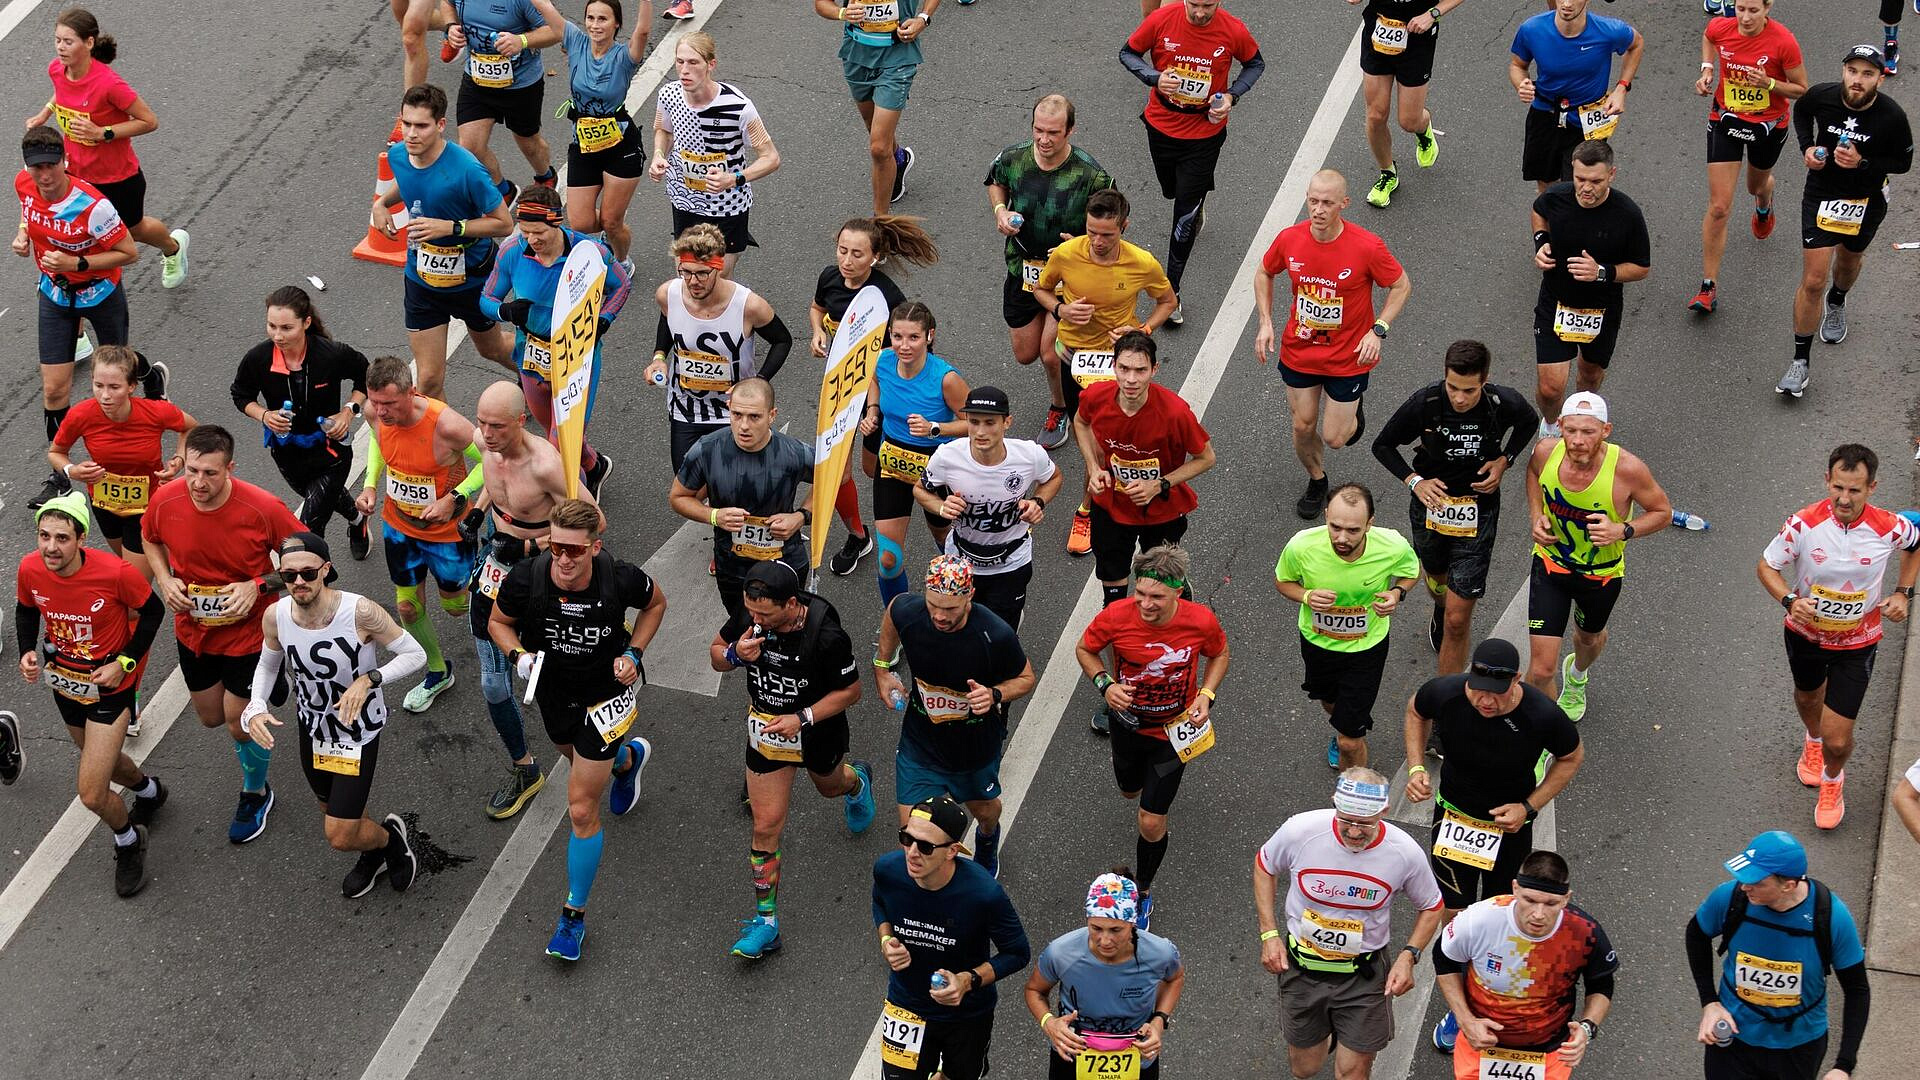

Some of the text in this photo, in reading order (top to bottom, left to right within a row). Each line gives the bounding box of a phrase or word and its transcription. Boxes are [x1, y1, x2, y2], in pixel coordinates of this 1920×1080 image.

[860, 4, 893, 18] 754
[472, 60, 510, 76] 16359
[1174, 55, 1213, 66] МАРАФОН
[1170, 76, 1205, 94] 157
[1731, 87, 1763, 102] 1866
[578, 120, 616, 140] 15521
[1727, 127, 1757, 142] Flinch
[1827, 125, 1871, 142] SAYSKY
[684, 163, 726, 176] 143
[1825, 201, 1864, 218] 14973
[101, 227, 122, 242] VOLGA
[422, 253, 458, 270] 7647
[1024, 266, 1042, 281] 13
[1299, 275, 1338, 288] МАРАФОН
[1300, 297, 1341, 319] 15023
[1559, 311, 1602, 330] 13545
[554, 299, 595, 378] 3:59
[685, 360, 724, 376] 2524
[1078, 354, 1114, 369] 5477
[829, 344, 868, 417] 3:59
[1449, 434, 1483, 442] МОГУ
[881, 453, 925, 476] 13829
[1113, 465, 1160, 481] 15889
[101, 482, 142, 500] 1513
[391, 480, 429, 500] 7958
[1430, 506, 1476, 521] 063
[735, 544, 743, 552] G
[483, 584, 491, 594] G
[1813, 597, 1863, 615] 12292
[46, 611, 91, 623] МАРАФОН
[1314, 612, 1366, 629] 10705
[551, 640, 571, 655] 5:40
[749, 664, 799, 697] 3:59
[608, 730, 617, 739] G
[319, 755, 325, 764] E
[1184, 747, 1192, 757] D
[1444, 822, 1500, 851] 10487
[1440, 847, 1449, 857] G
[1347, 885, 1379, 901] SPORT
[893, 925, 957, 946] PACEMAKER
[1311, 929, 1347, 947] 420
[1738, 966, 1798, 990] 14269
[882, 1016, 920, 1044] 5191
[1084, 1054, 1133, 1073] 7237
[1488, 1061, 1536, 1080] 4446
